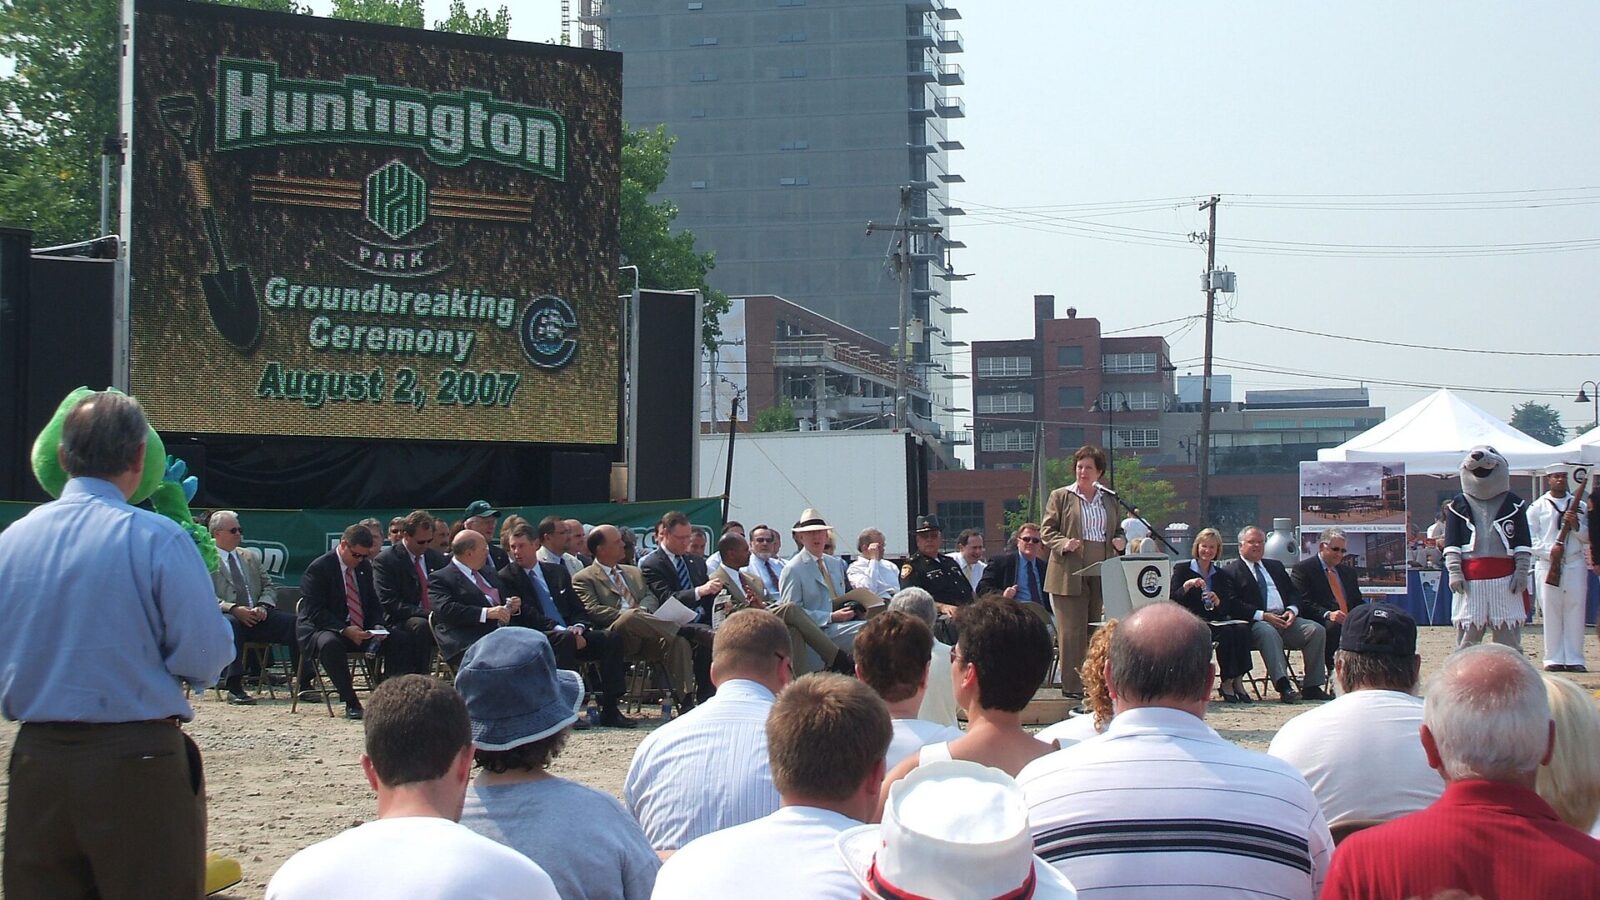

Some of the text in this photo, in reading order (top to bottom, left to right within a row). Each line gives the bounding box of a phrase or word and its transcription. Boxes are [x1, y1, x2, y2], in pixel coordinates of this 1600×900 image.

[222, 67, 558, 170] Huntington
[359, 246, 424, 269] PARK
[265, 276, 516, 328] Groundbreaking
[309, 316, 475, 362] Ceremony
[255, 361, 521, 410] August 2, 2007
